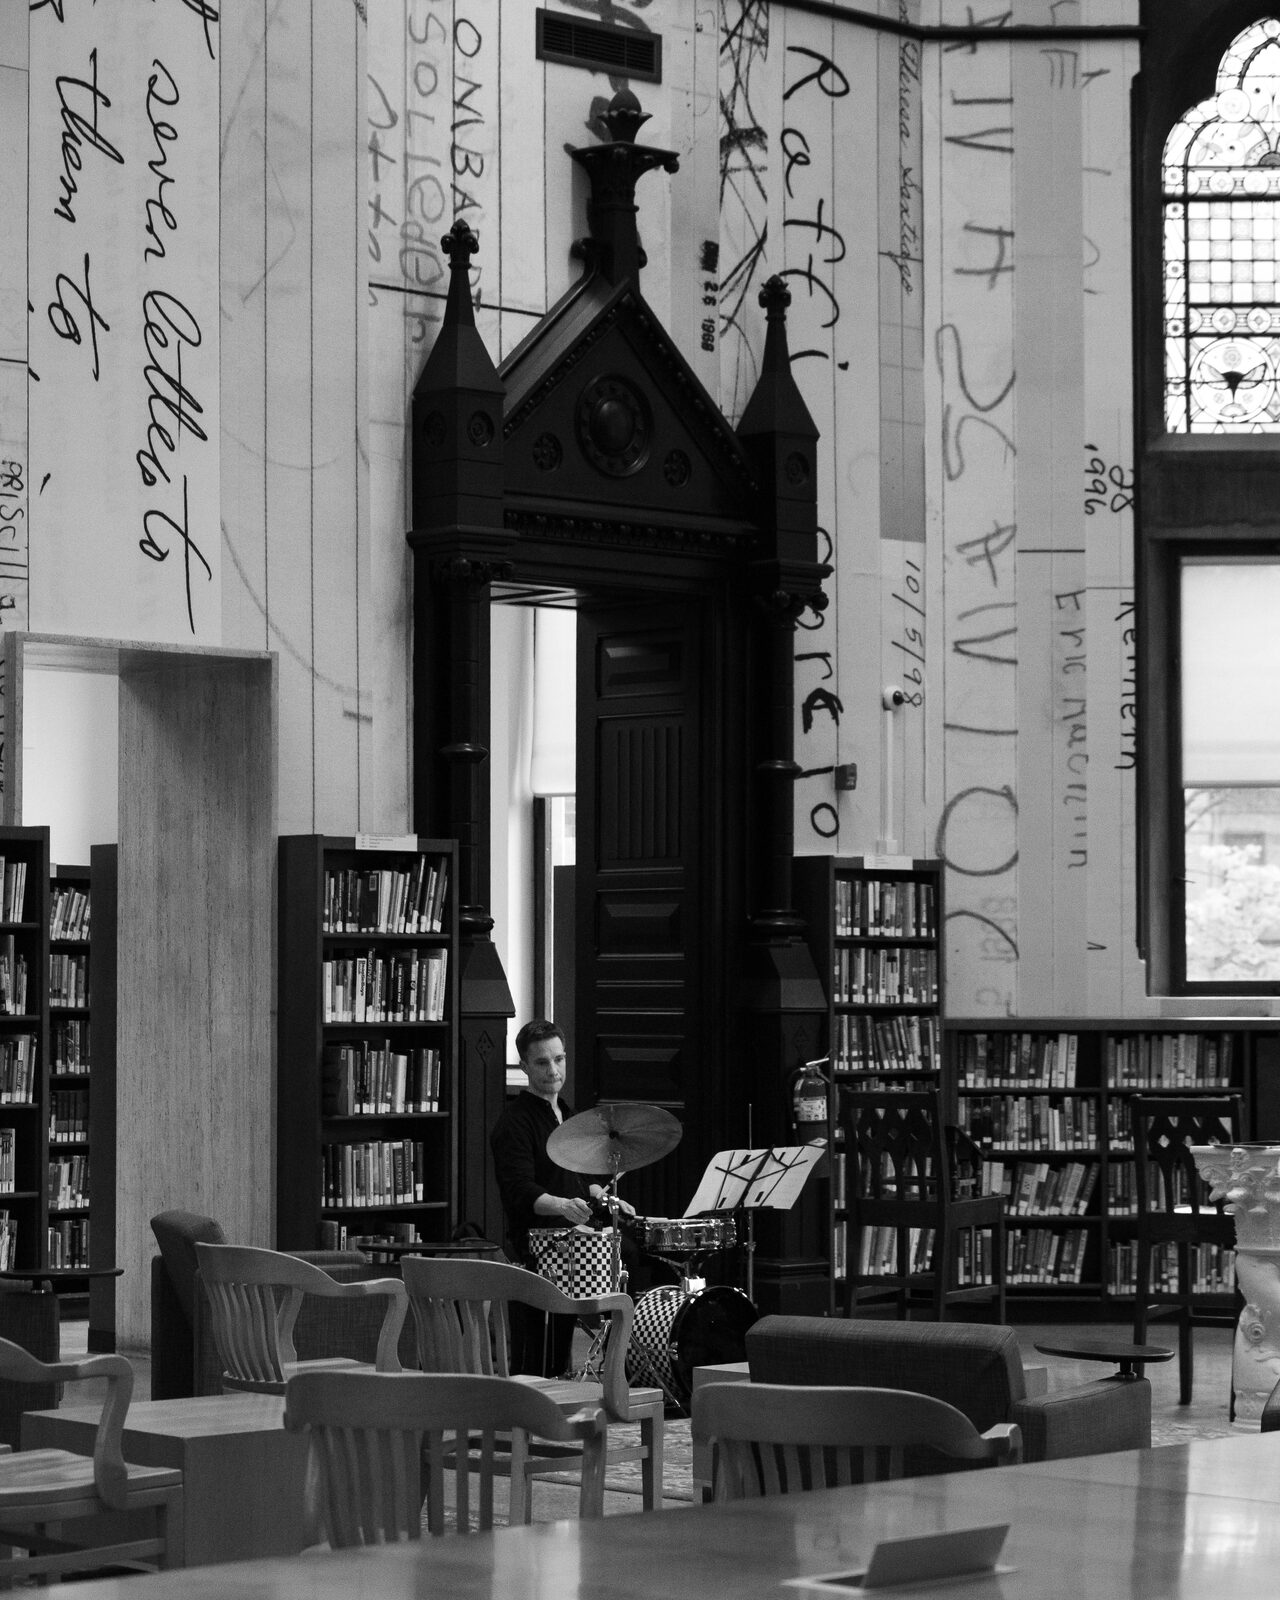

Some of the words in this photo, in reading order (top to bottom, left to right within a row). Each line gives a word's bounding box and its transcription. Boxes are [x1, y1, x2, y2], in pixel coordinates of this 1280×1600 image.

[54, 47, 126, 224] them
[144, 58, 180, 264] seven
[780, 45, 851, 371] Raffi
[48, 253, 111, 382] to
[139, 474, 213, 636] to
